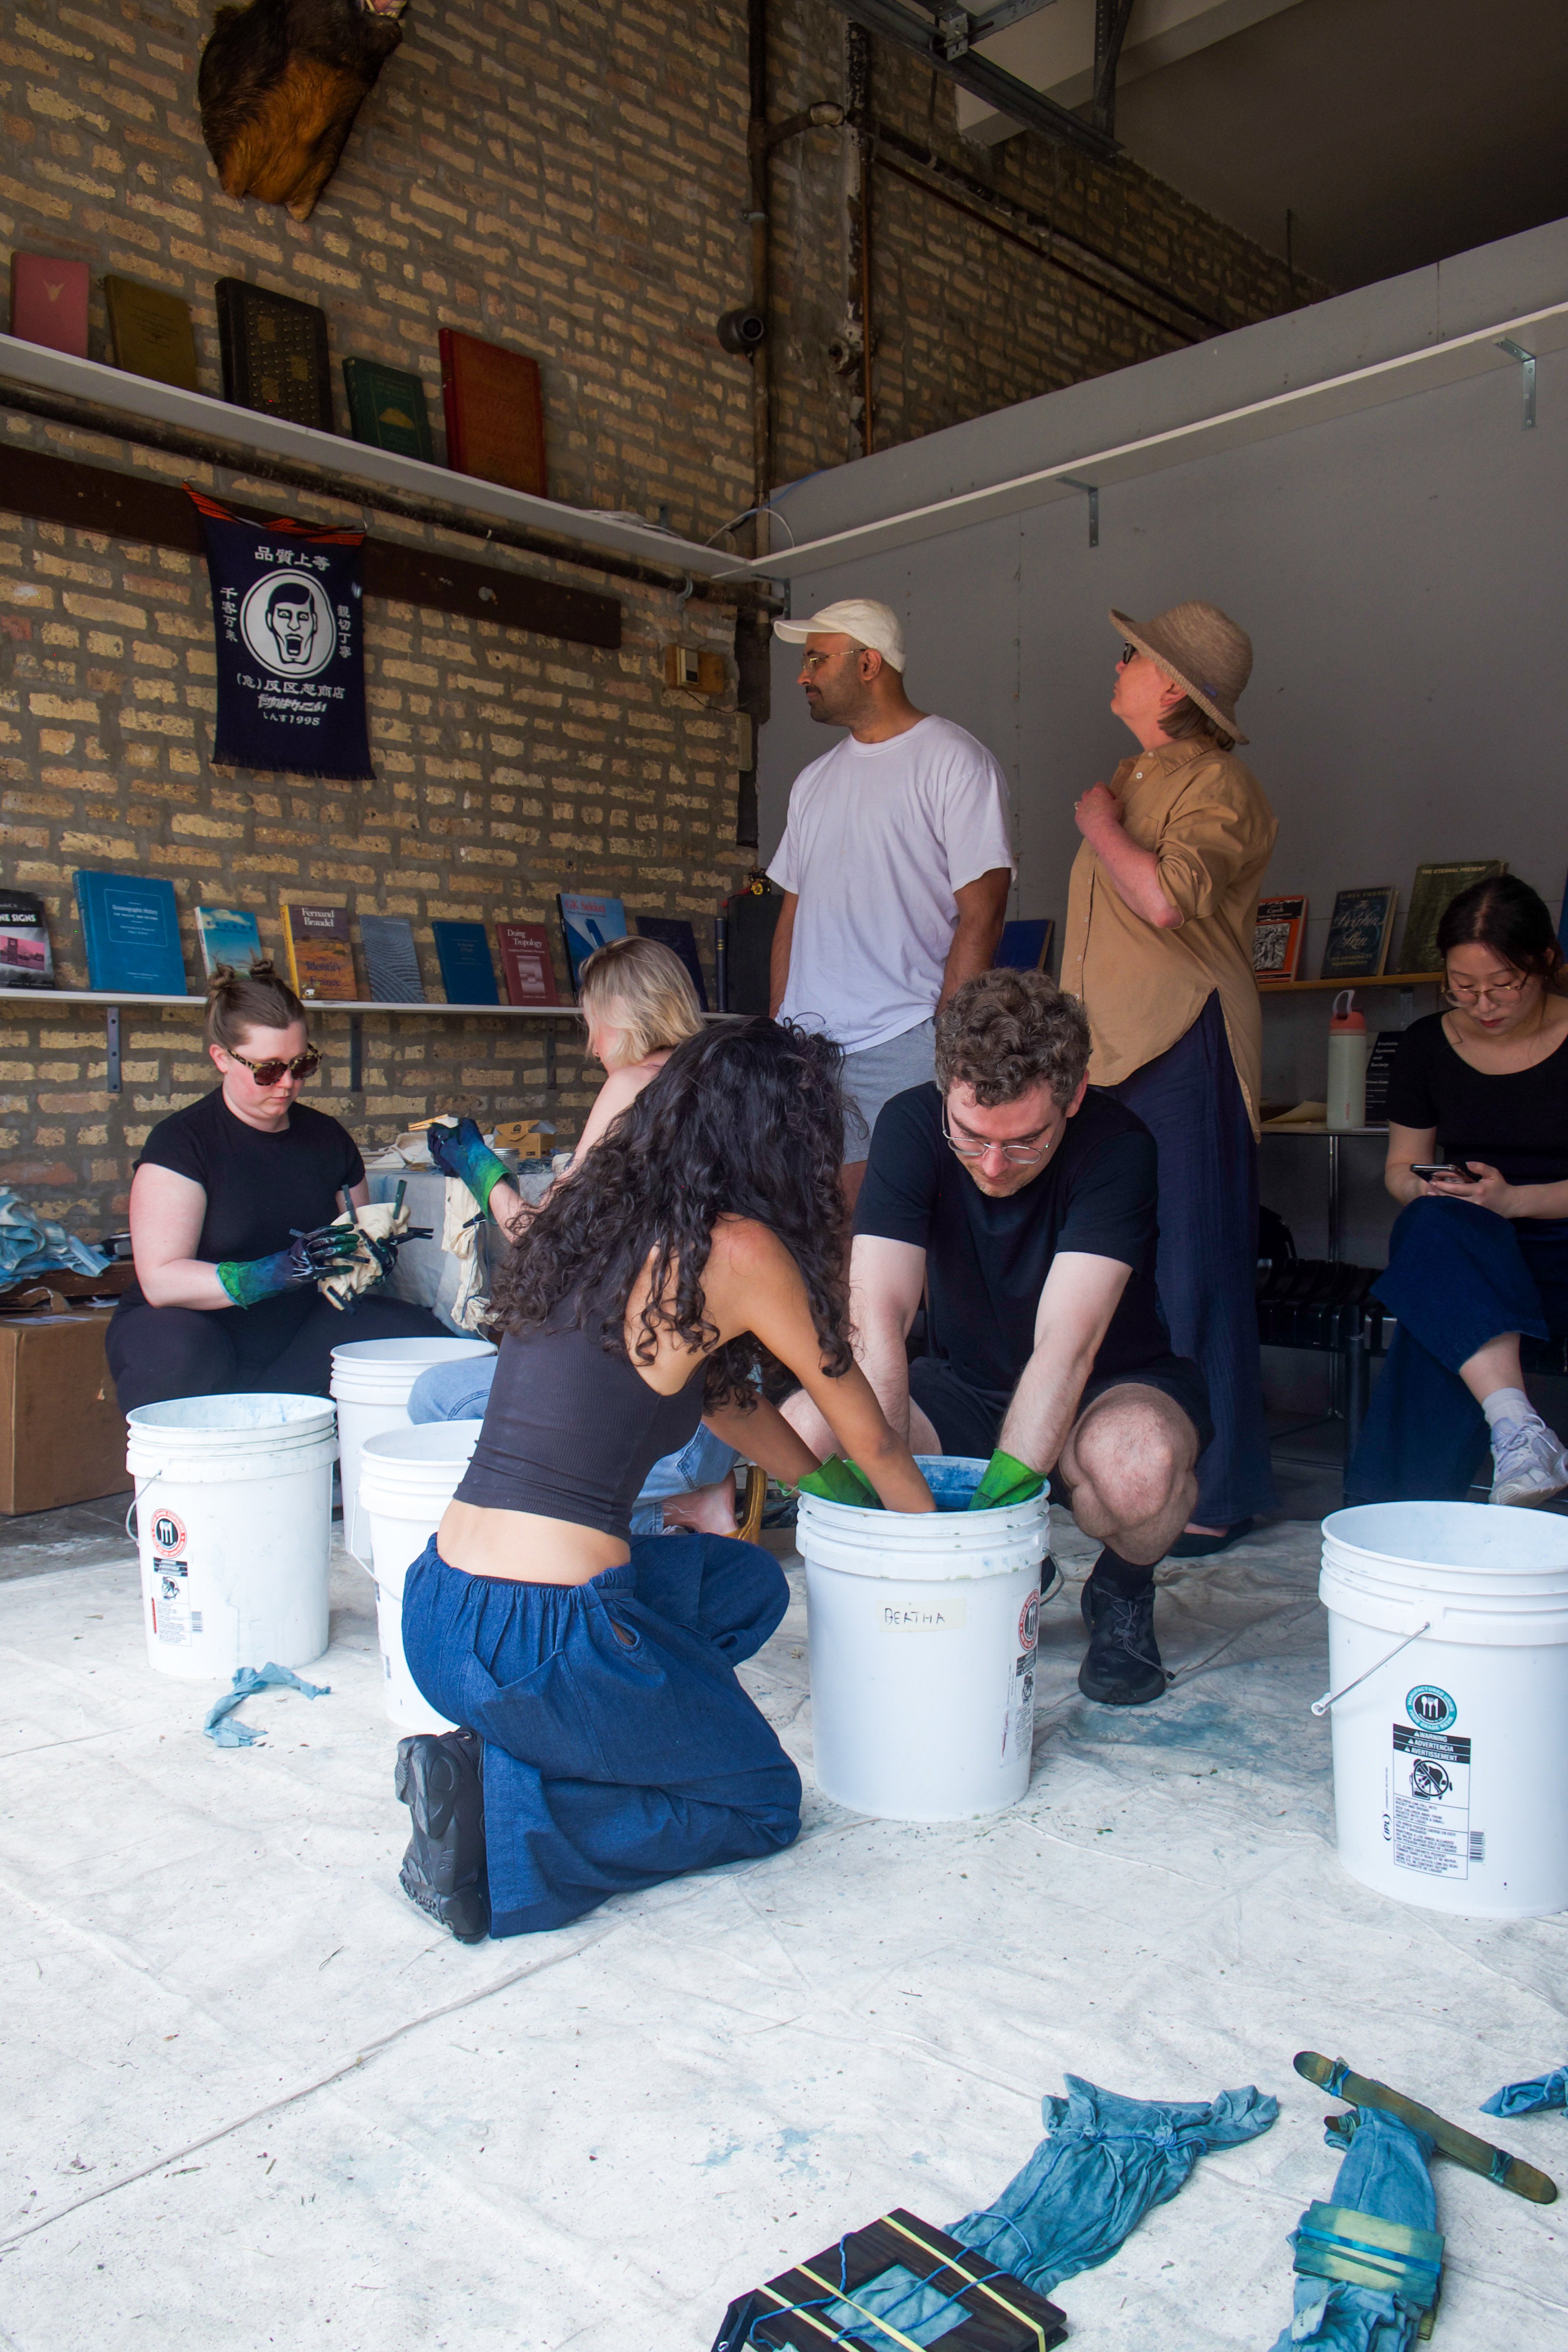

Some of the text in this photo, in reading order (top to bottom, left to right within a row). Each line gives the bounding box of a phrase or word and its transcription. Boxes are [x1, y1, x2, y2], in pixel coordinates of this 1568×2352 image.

[255, 546, 331, 572] 品質上等
[220, 587, 238, 642] 千客万来
[337, 604, 352, 659] 親切丁寧
[301, 907, 335, 918] Fernand
[304, 917, 334, 927] Braudel
[507, 929, 526, 938] Doing
[513, 938, 542, 948] Tropology
[884, 1607, 946, 1625] BERTHA
[1408, 1686, 1455, 1712] MANUFACTURED USING
[1409, 1709, 1421, 1724] FOOD
[1420, 1722, 1440, 1730] GRADE
[1440, 1716, 1454, 1729] RESIN
[1420, 1731, 1447, 1742] WARNING
[1414, 1739, 1454, 1752] ADVERTENCIA
[1411, 1747, 1458, 1761] AVERTISSEMENT
